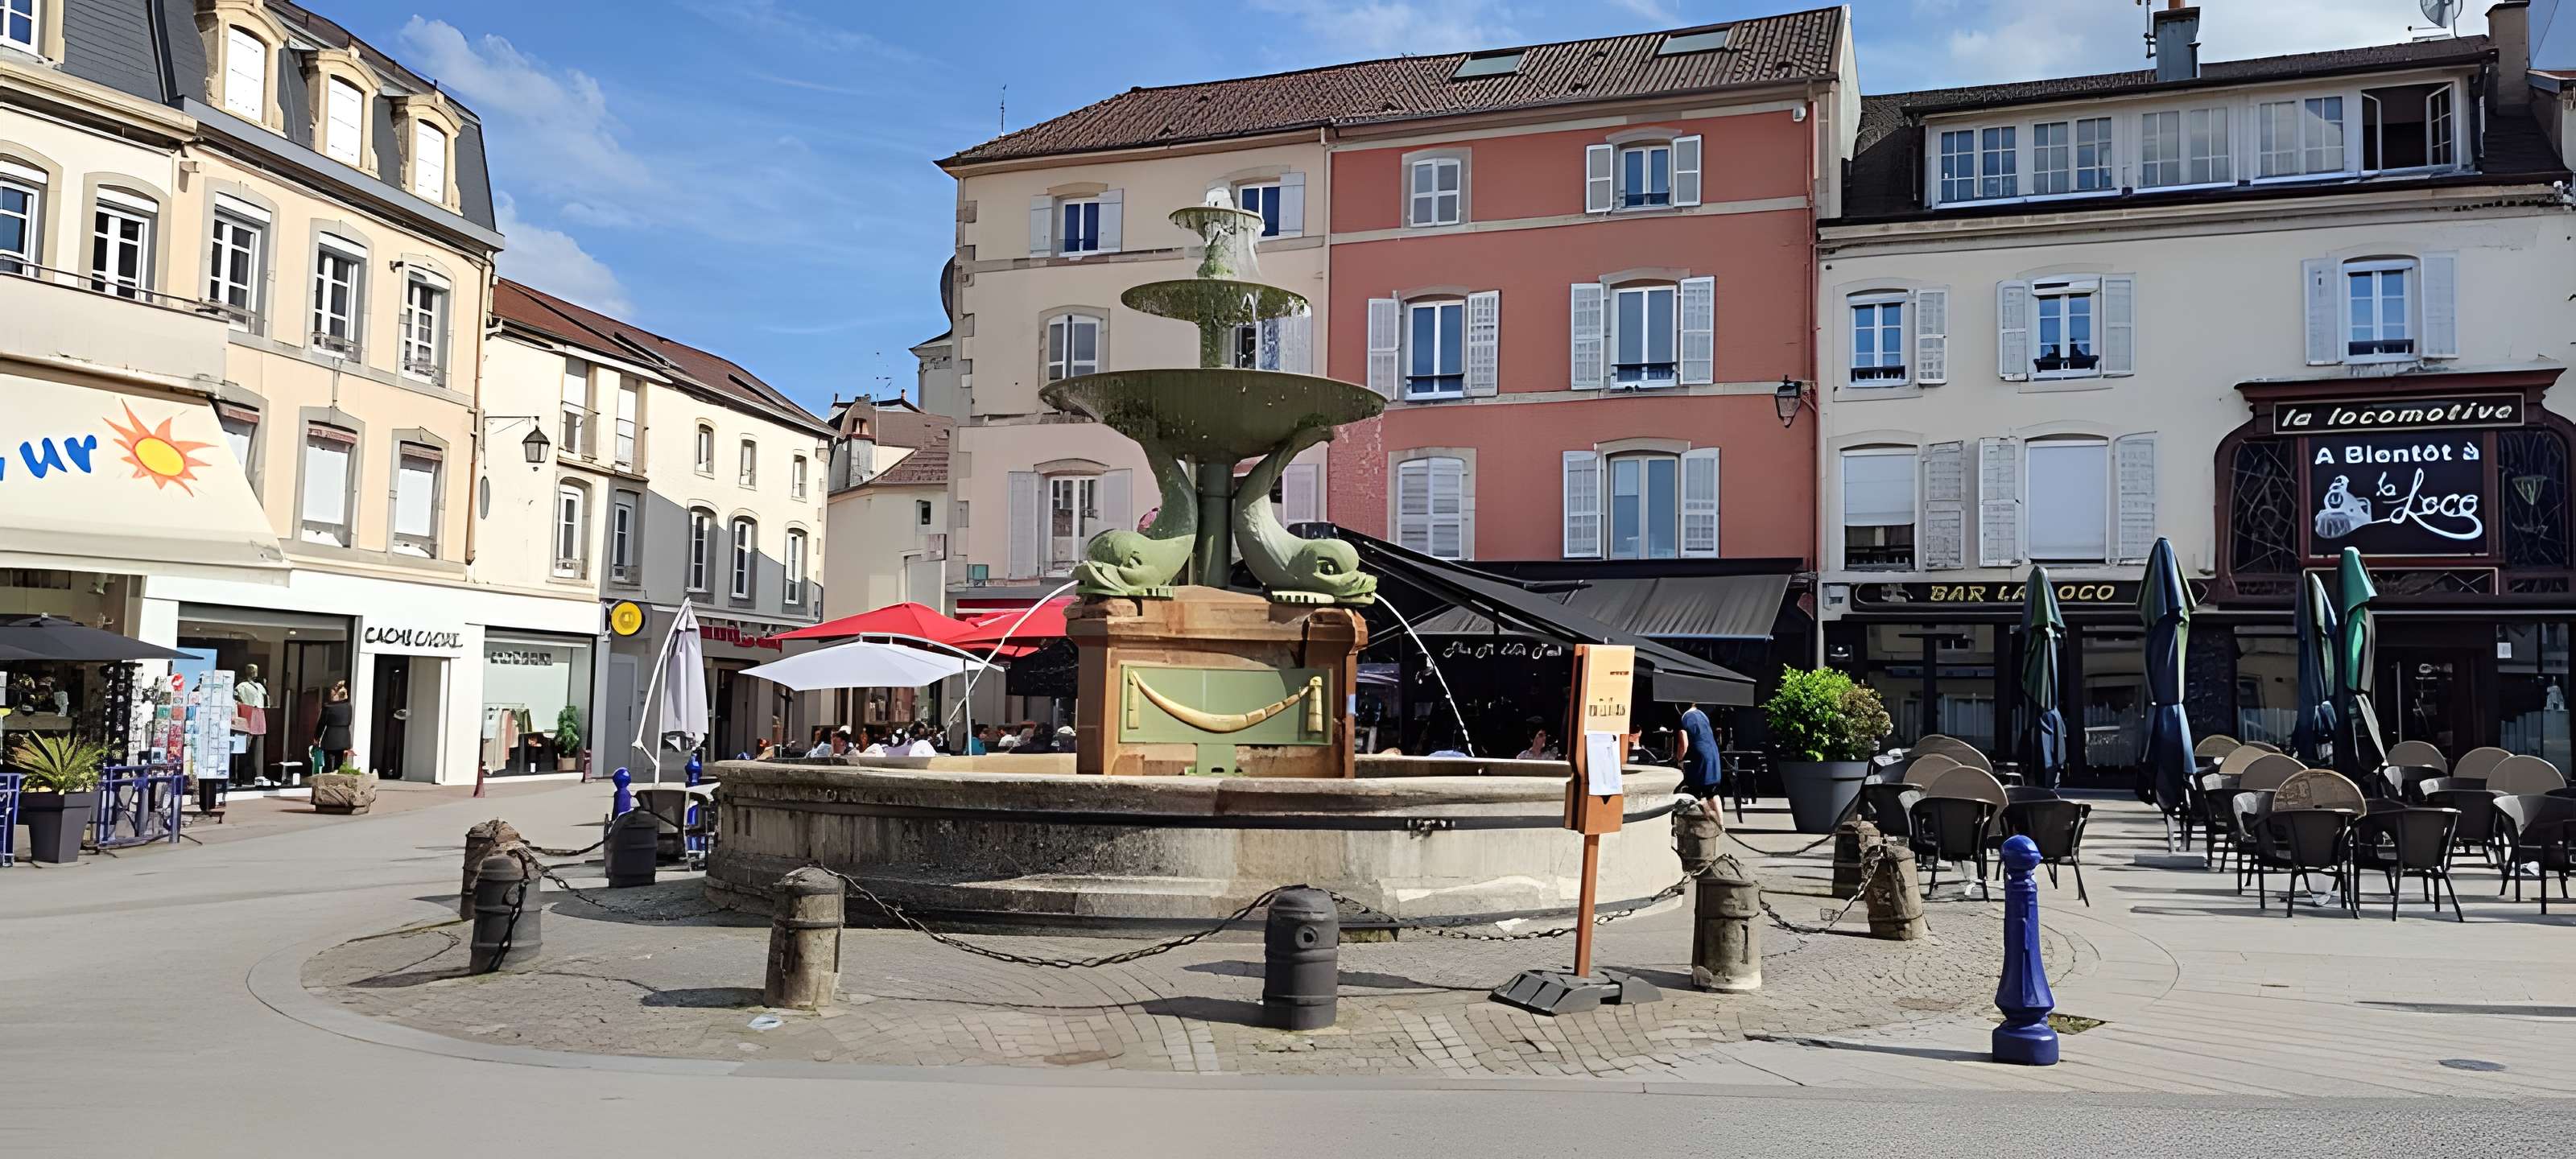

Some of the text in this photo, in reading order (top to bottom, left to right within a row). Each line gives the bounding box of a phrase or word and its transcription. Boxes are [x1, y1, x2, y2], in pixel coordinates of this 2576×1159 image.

[2281, 402, 2512, 427] la locomotive
[0, 435, 97, 481] ur
[2314, 447, 2334, 465] A
[2388, 468, 2483, 540] Loco
[1930, 585, 1986, 603] BAR
[2058, 585, 2115, 600] OCO
